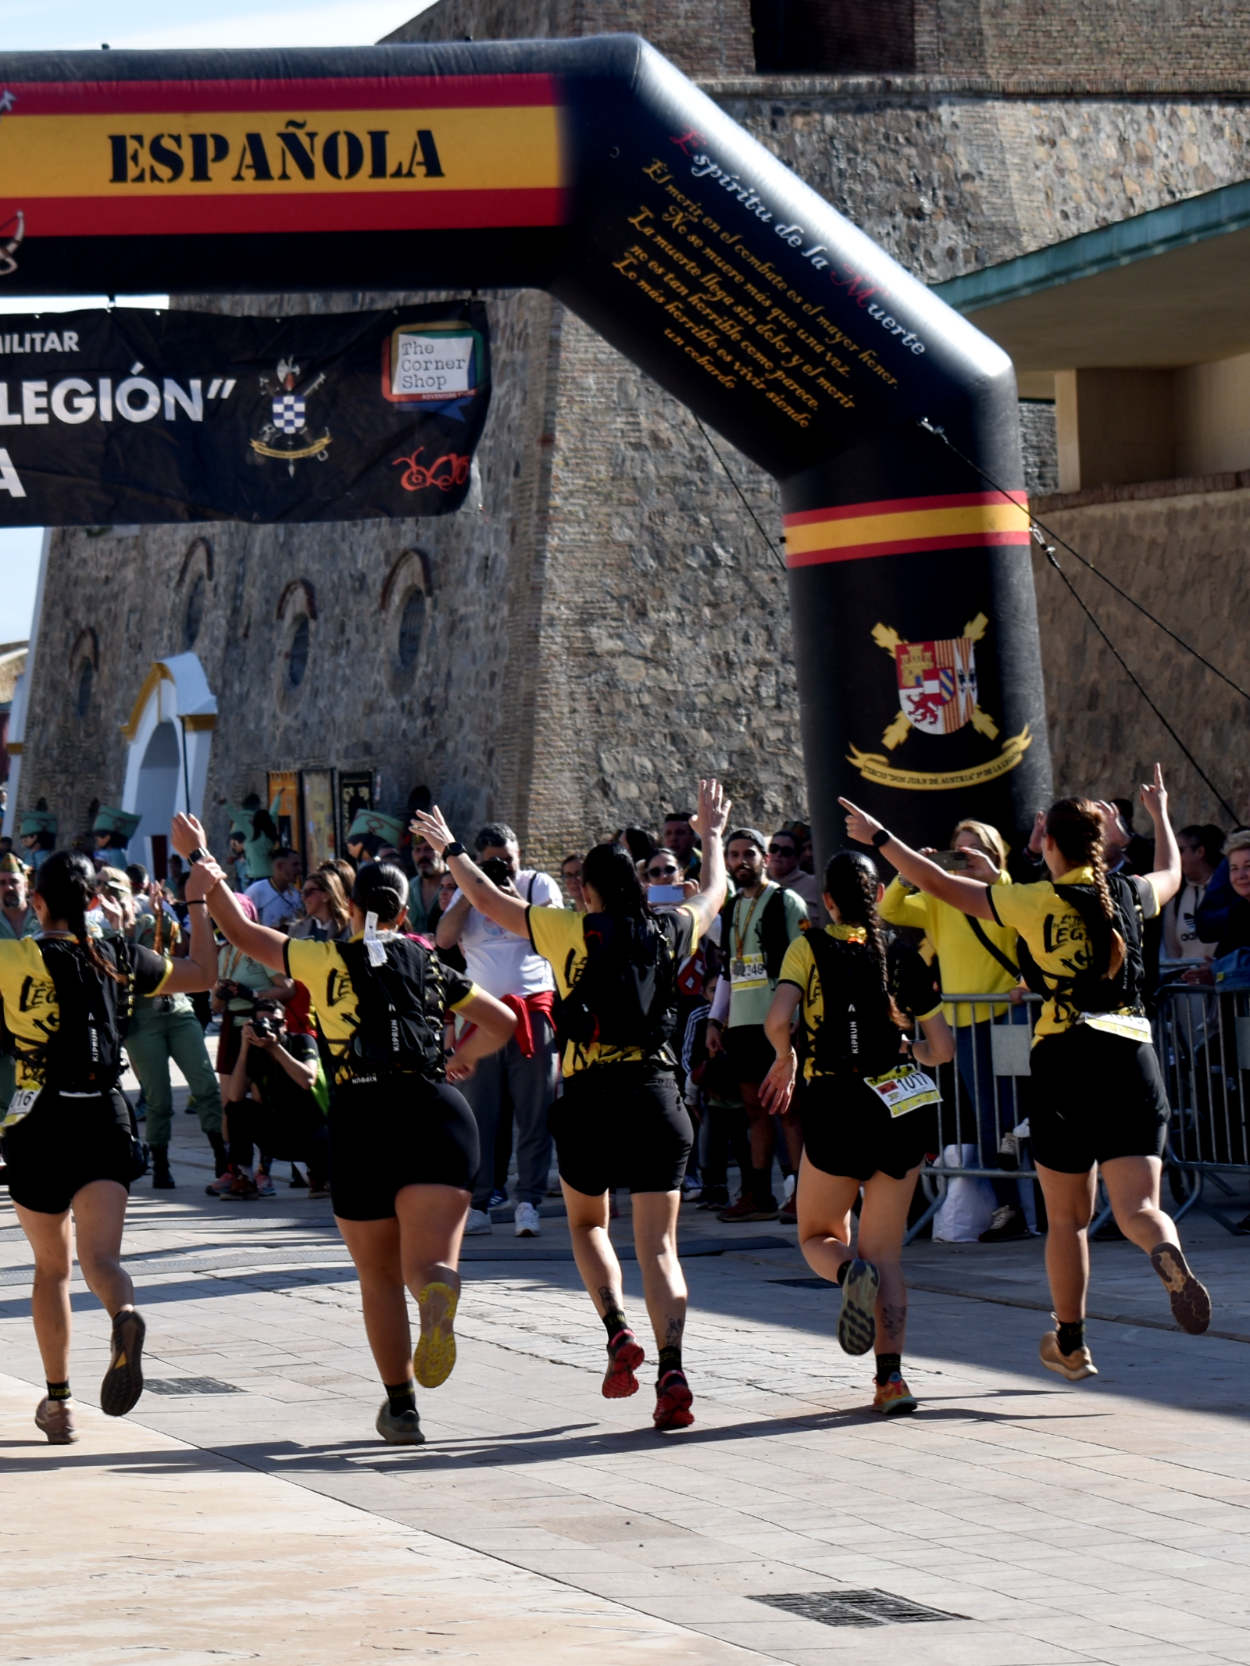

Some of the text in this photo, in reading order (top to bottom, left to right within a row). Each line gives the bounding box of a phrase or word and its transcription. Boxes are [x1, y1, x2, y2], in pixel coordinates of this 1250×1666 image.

[107, 119, 446, 184] ESPAÑOLA
[664, 183, 703, 216] morir
[701, 216, 720, 233] en
[719, 231, 742, 244] el
[733, 244, 787, 290] combate
[786, 289, 803, 303] es
[801, 302, 824, 315] el
[815, 315, 859, 351] mayor
[774, 220, 803, 249] de
[802, 245, 830, 270] la
[829, 261, 929, 355] Muerte
[627, 205, 855, 408] La muerte llega sin dolor y el morir
[662, 205, 850, 377] No se muere más que una vez.
[401, 341, 435, 356] The
[611, 251, 811, 427] Lo más horrible es vivir siendo
[629, 244, 818, 410] no es tan horrible como parece.
[401, 358, 466, 373] Corner
[663, 327, 737, 388] un cobarde
[402, 374, 447, 391] Shop
[862, 764, 888, 781] TERCIO
[907, 776, 928, 786] JUAN
[928, 777, 940, 785] DE
[983, 767, 995, 778] DE
[391, 1019, 401, 1052] KIPRUN
[850, 1022, 859, 1054] KIPRUN
[352, 1076, 377, 1085] KIPRUN
[897, 1073, 928, 1092] 1017
